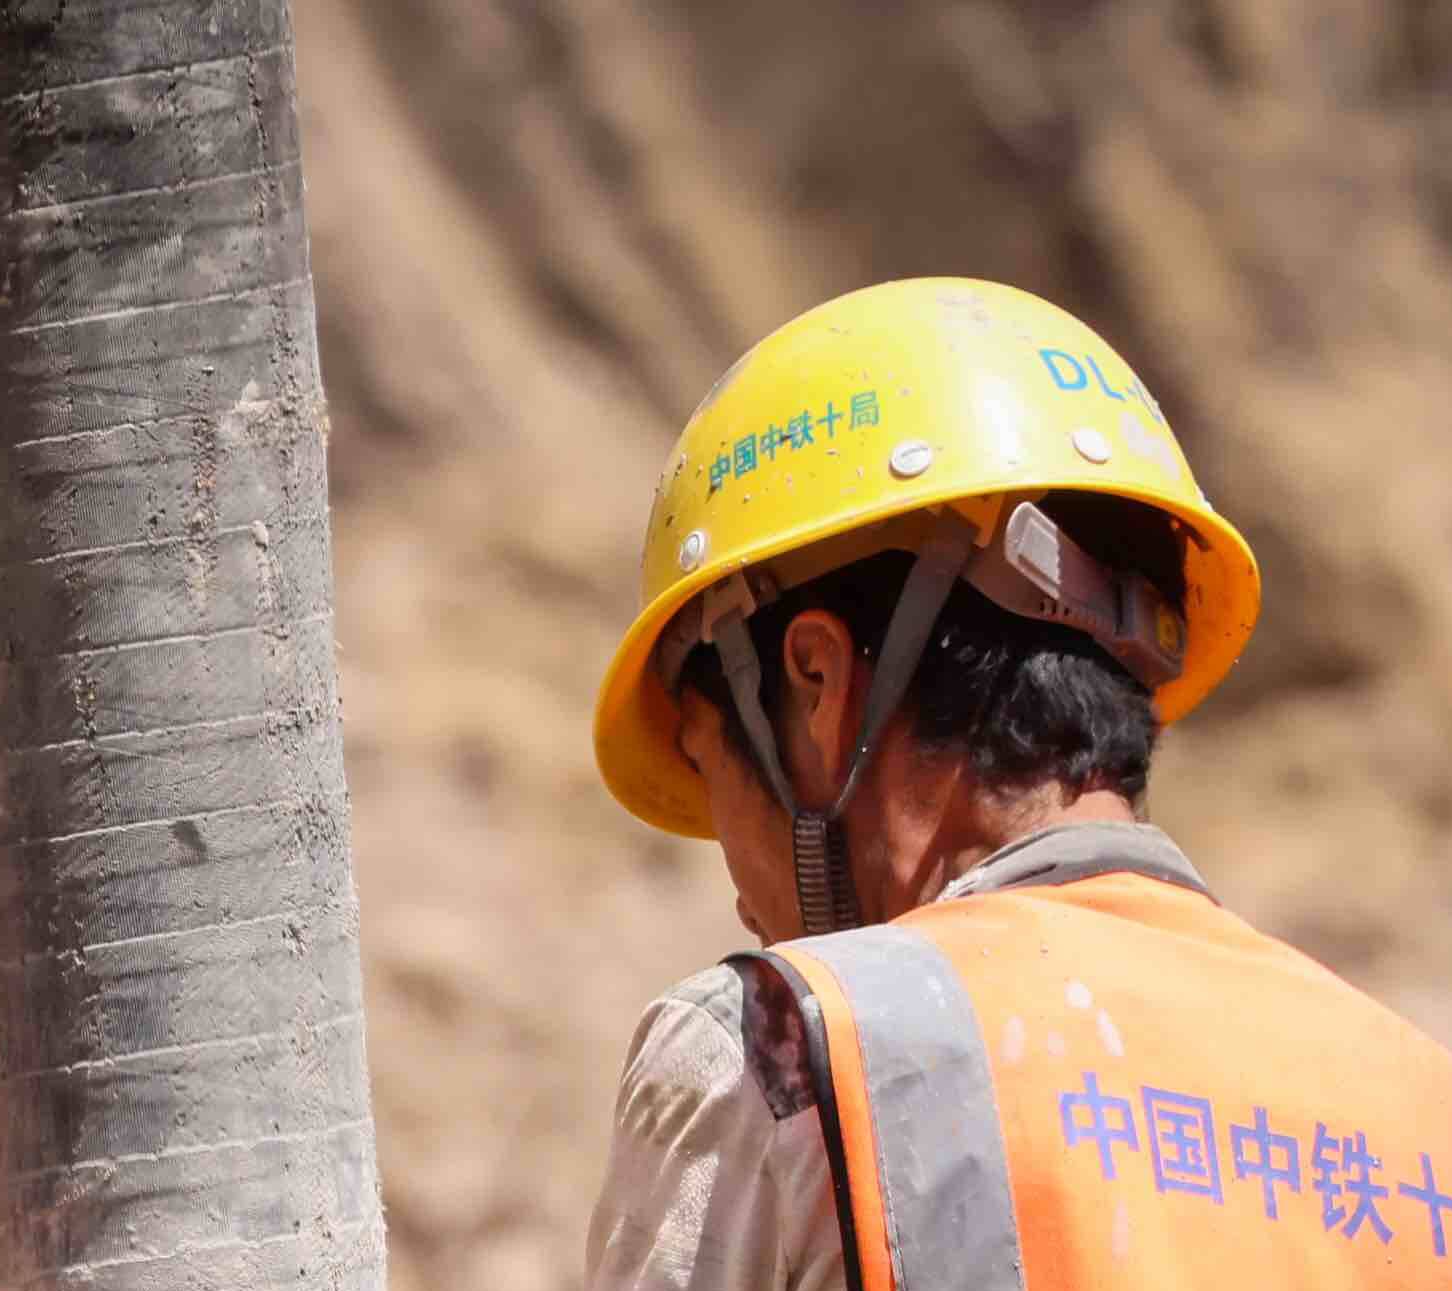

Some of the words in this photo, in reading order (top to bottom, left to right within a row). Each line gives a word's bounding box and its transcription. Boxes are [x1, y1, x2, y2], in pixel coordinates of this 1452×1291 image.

[710, 389, 880, 489] 中国中铁十局
